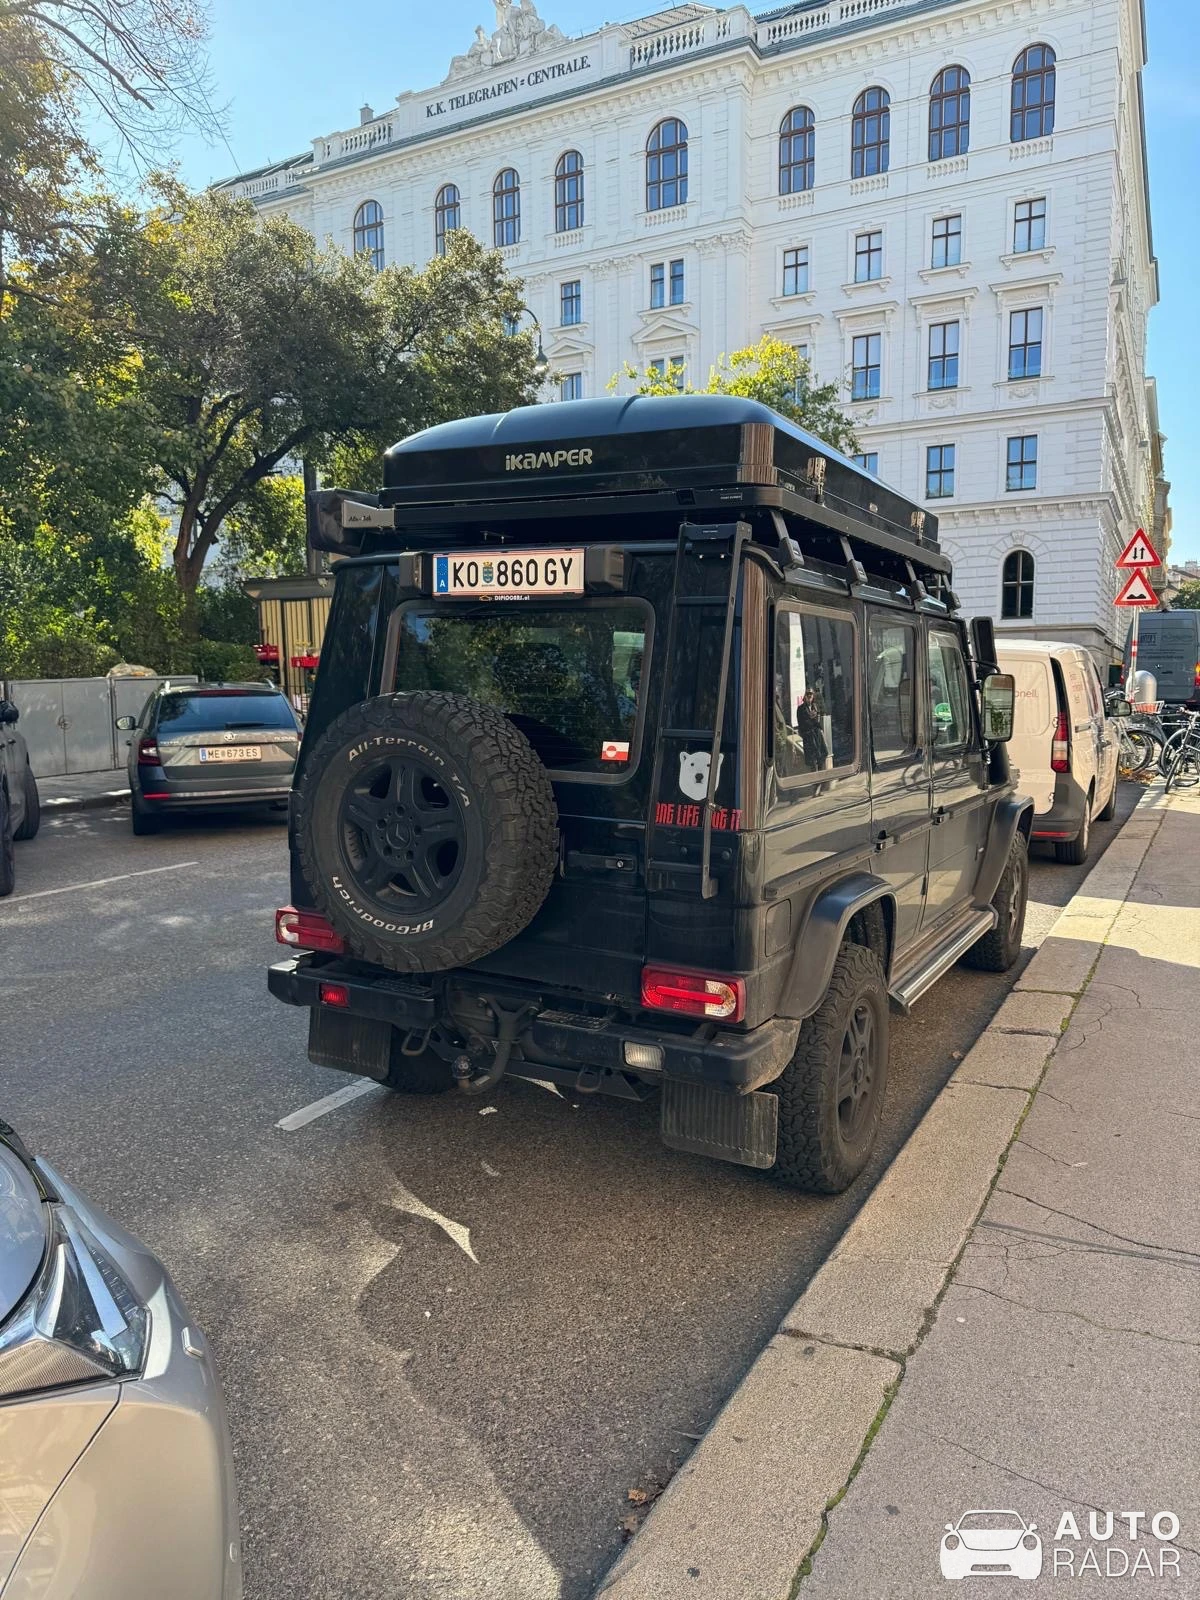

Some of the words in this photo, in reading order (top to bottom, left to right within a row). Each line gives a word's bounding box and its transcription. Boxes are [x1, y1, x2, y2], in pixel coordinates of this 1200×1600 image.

[426, 101, 447, 118] K.K.
[449, 77, 518, 110] TELEGRAFEN
[439, 579, 446, 588] A
[348, 736, 445, 767] All-Terrain
[332, 876, 435, 935] BFGoodrich
